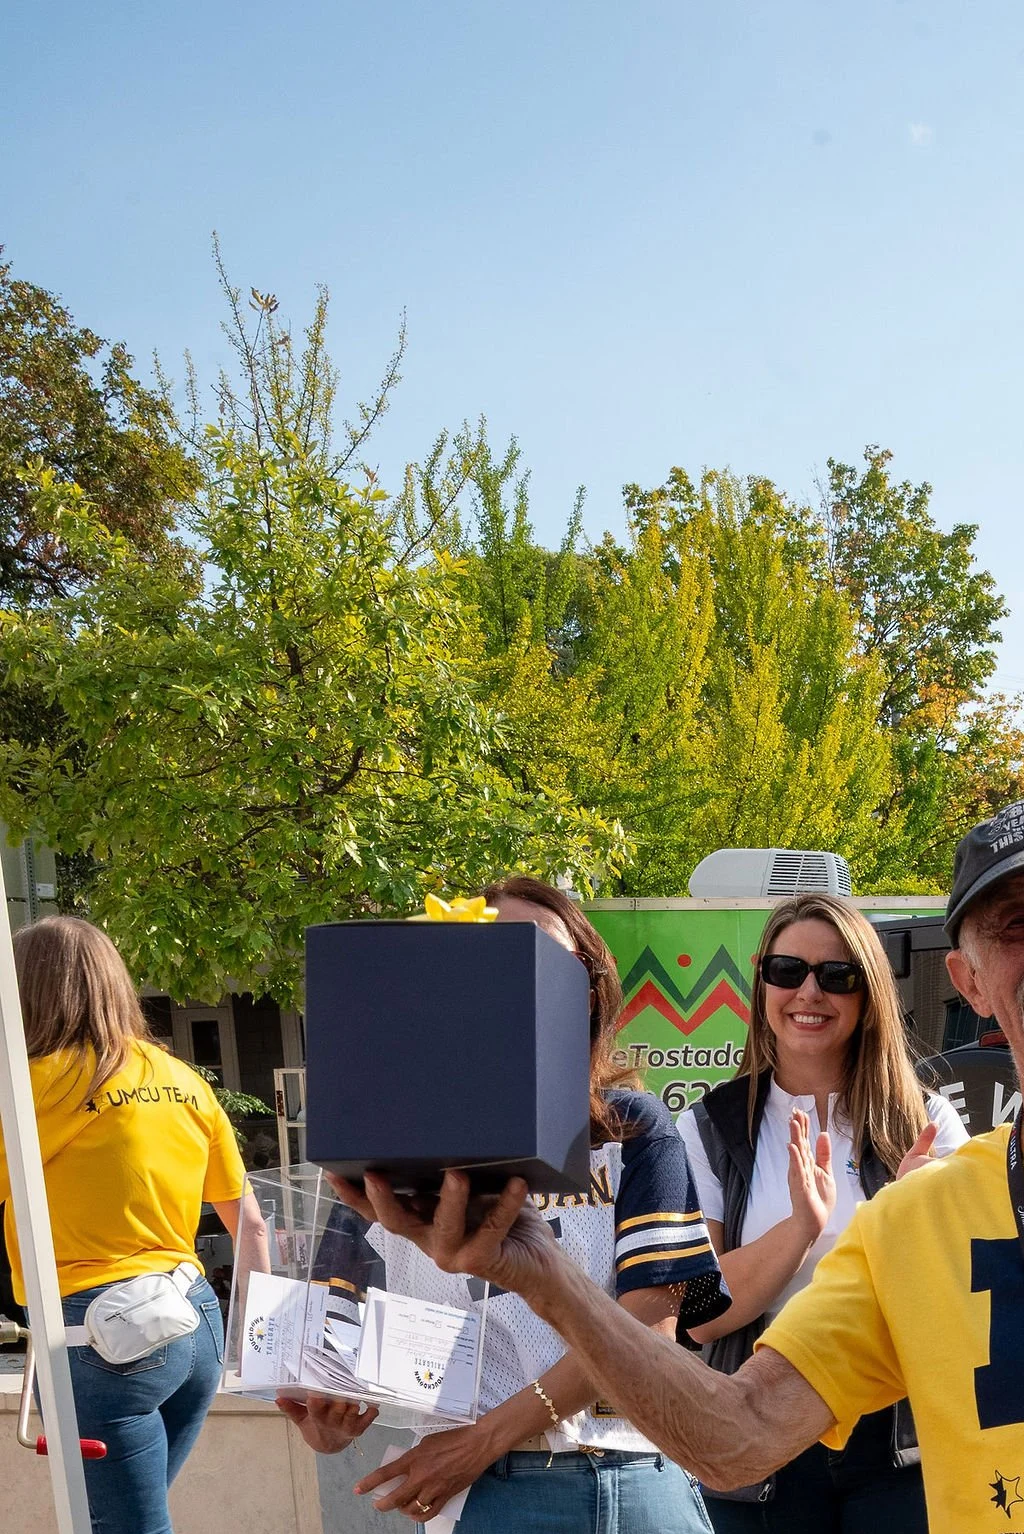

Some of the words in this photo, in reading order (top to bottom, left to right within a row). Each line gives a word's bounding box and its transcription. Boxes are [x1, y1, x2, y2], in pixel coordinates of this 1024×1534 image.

[990, 831, 1024, 853] THIS
[106, 1087, 160, 1107] UMCU
[162, 1086, 199, 1110] TEAM
[248, 1316, 264, 1353] TOUCHDOWN
[266, 1317, 275, 1355] TAILGATE
[414, 1357, 445, 1371] TAILGATE
[414, 1370, 444, 1390] TOUCHDOWN
